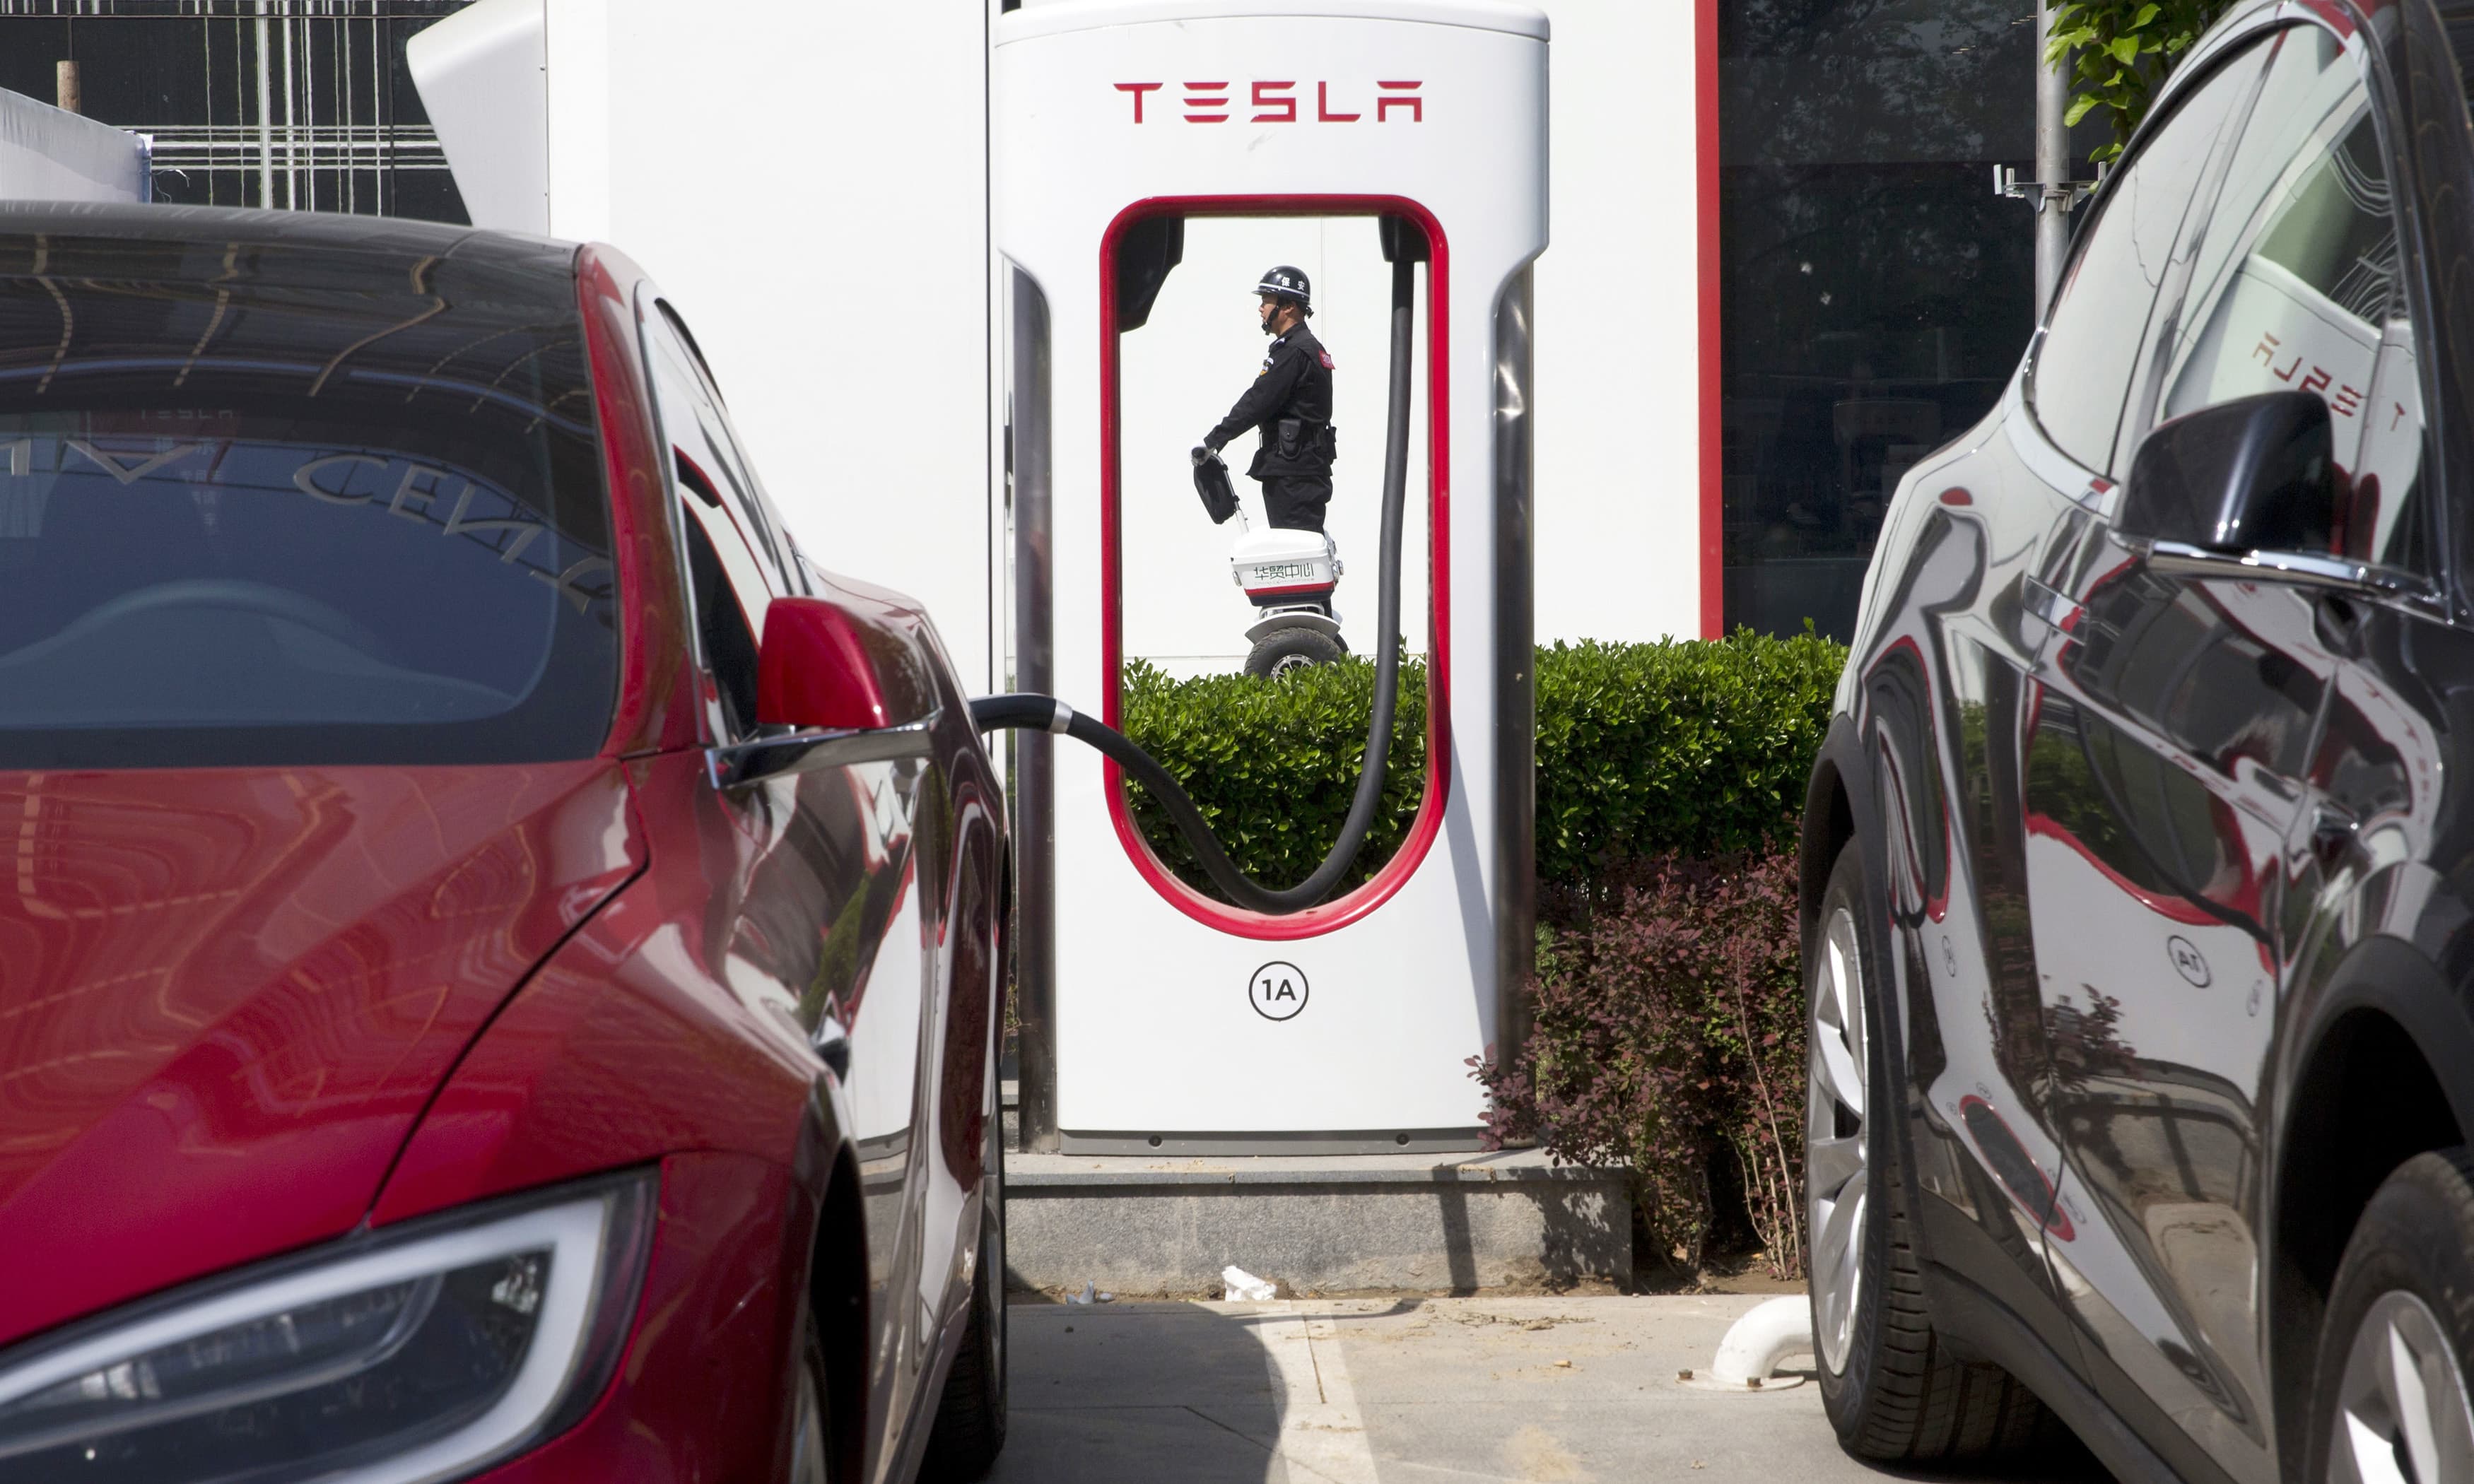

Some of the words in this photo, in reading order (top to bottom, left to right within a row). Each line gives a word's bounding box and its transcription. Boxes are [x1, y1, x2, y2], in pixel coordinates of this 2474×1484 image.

[1113, 81, 1423, 124] TESLA
[1282, 276, 1305, 290] 保安
[1253, 563, 1314, 580] 华贸中心
[1262, 979, 1296, 1001] 1A
